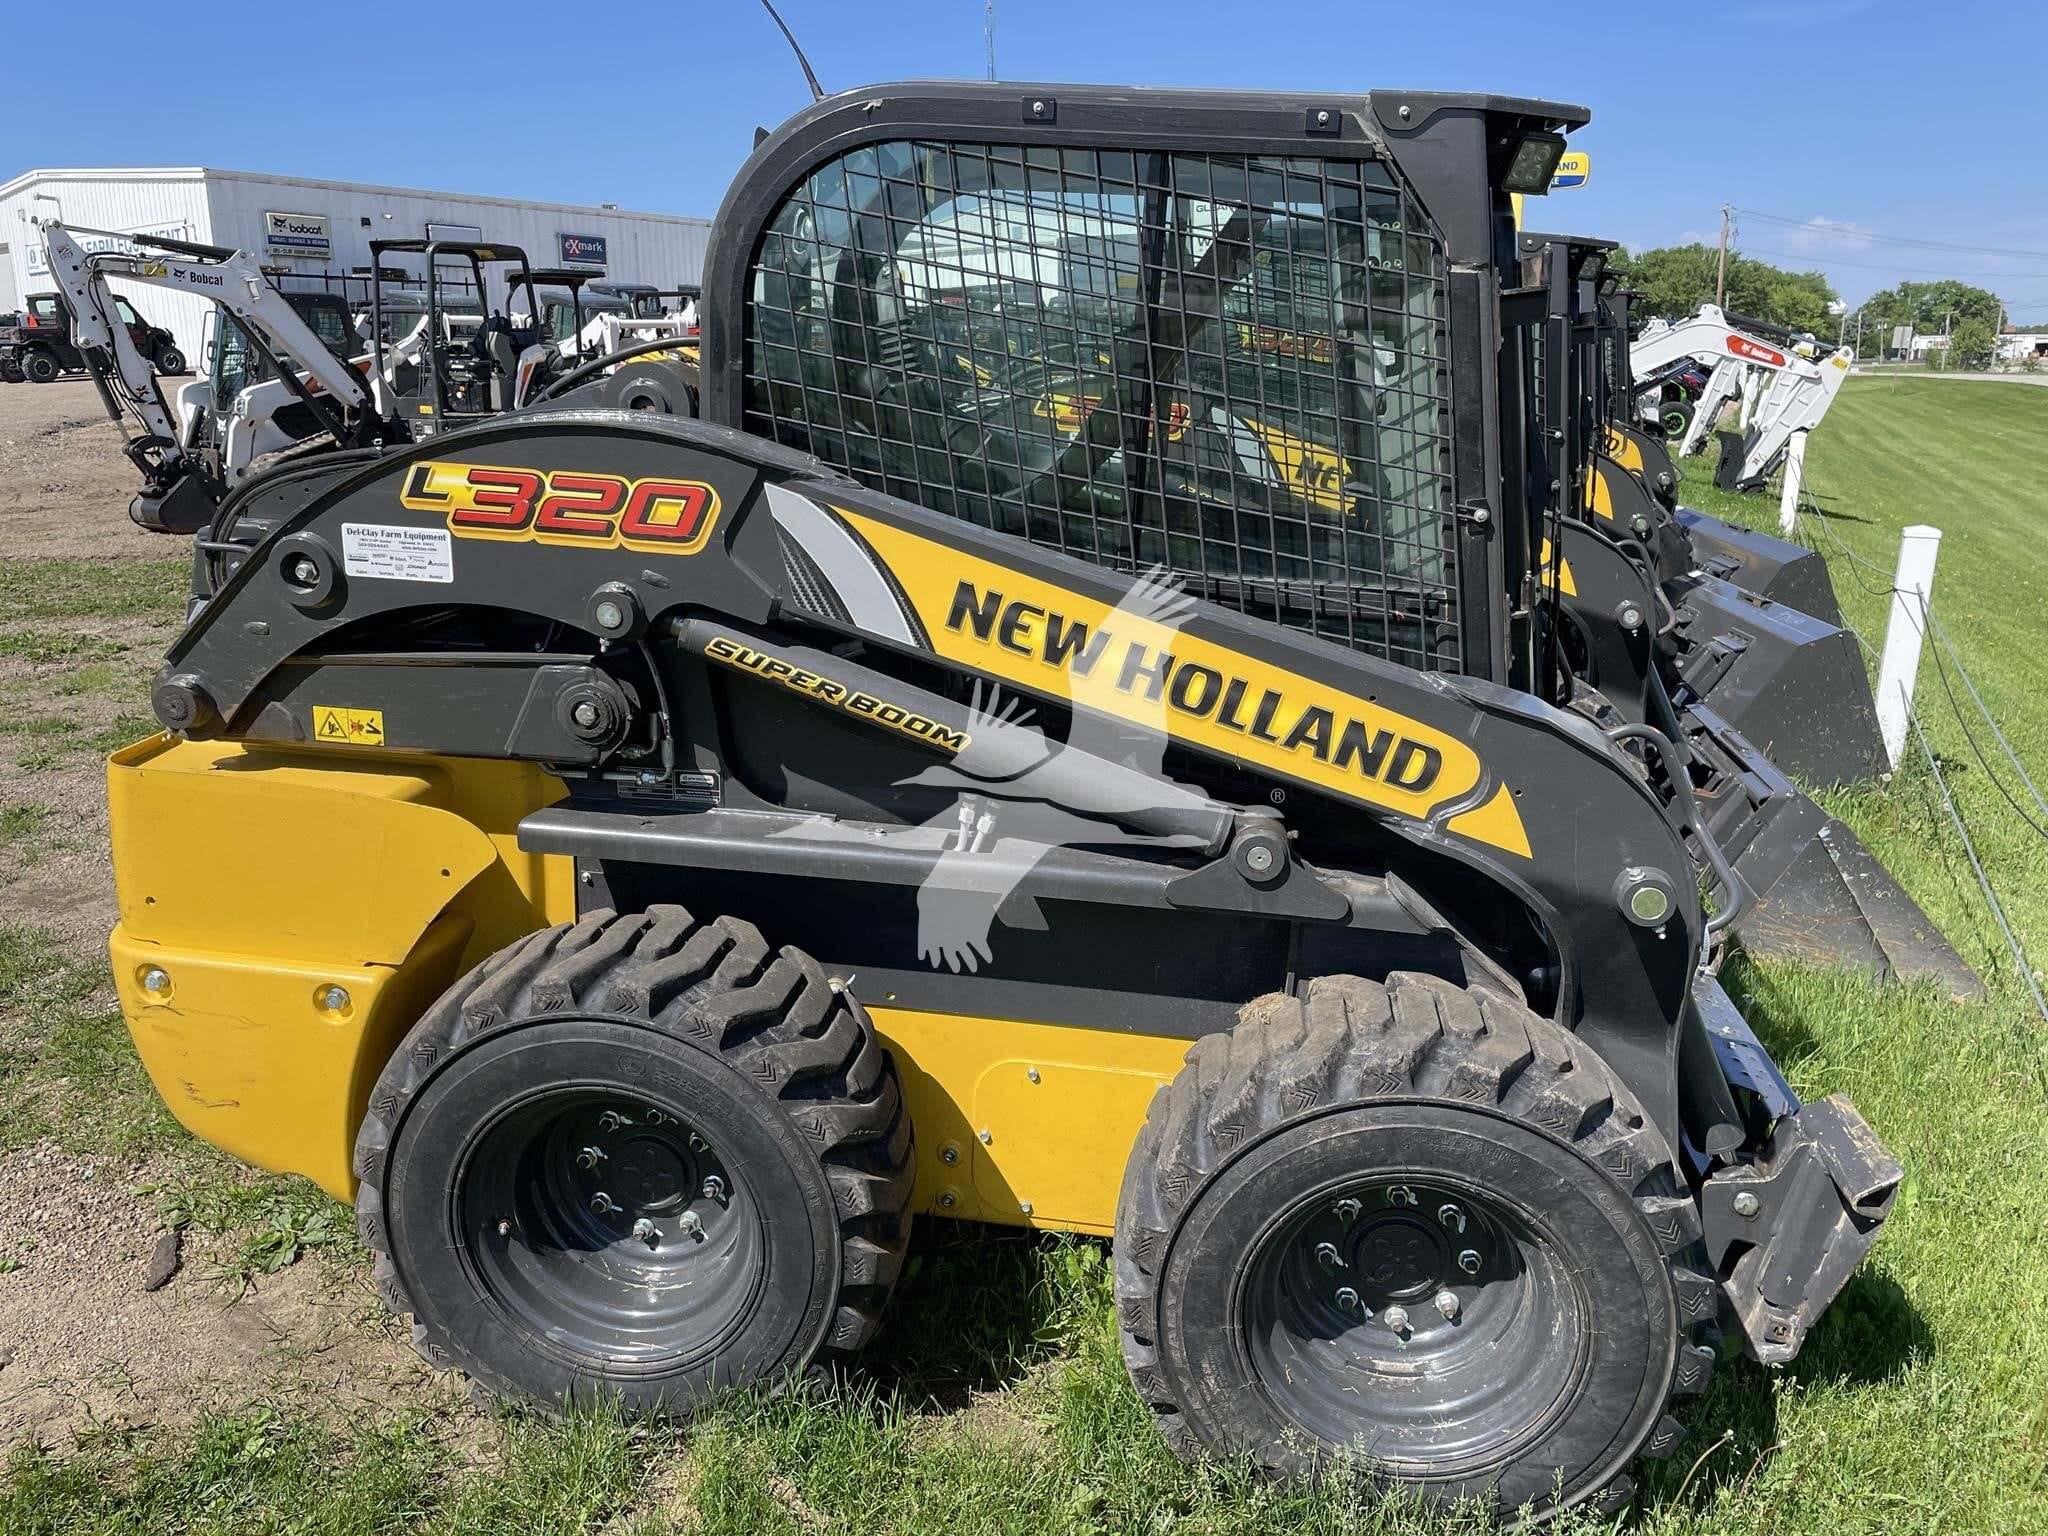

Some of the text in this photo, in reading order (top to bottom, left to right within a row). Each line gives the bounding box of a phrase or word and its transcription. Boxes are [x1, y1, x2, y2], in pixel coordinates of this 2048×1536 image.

[289, 223, 322, 235] bobcat
[86, 238, 114, 253] FARM
[565, 239, 603, 254] eXmark
[190, 271, 223, 286] Bobcat
[406, 465, 714, 545] L320
[346, 527, 446, 541] Del-Clay Farm Equipment
[944, 579, 1443, 794] NEW HOLLAND
[705, 637, 972, 752] SUPER BOOM
